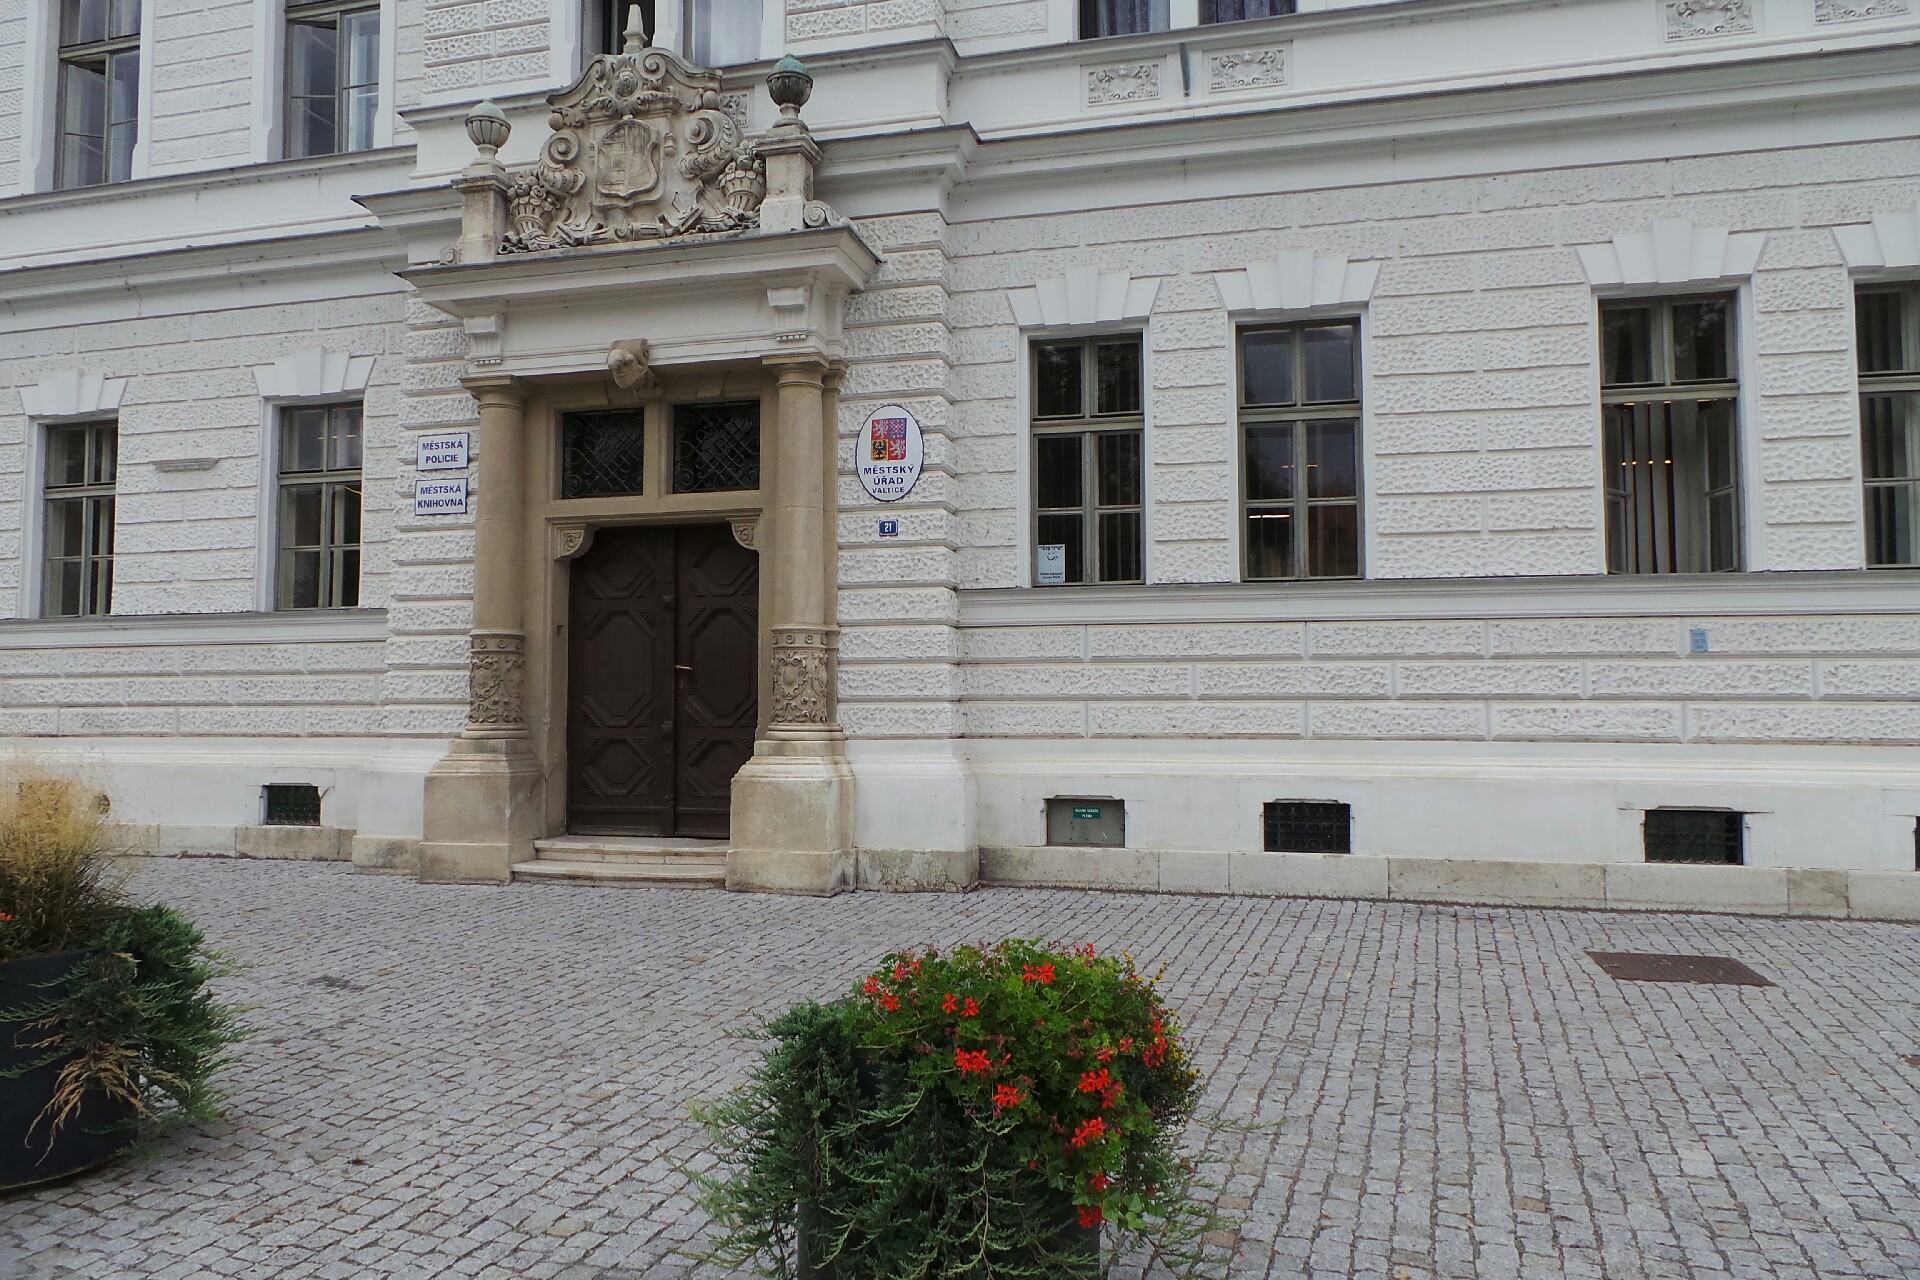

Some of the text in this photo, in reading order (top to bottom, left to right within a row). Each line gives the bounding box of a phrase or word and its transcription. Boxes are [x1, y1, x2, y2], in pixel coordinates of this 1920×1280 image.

[422, 438, 463, 450] MĚSTSKÁ
[426, 454, 459, 463] POLICIE
[864, 464, 914, 475] MĚSTSKÝ
[873, 475, 904, 485] ÚŘAD
[420, 483, 461, 495] MĚSTSKÁ
[417, 499, 463, 509] KNIHOVNA
[884, 523, 892, 532] 21
